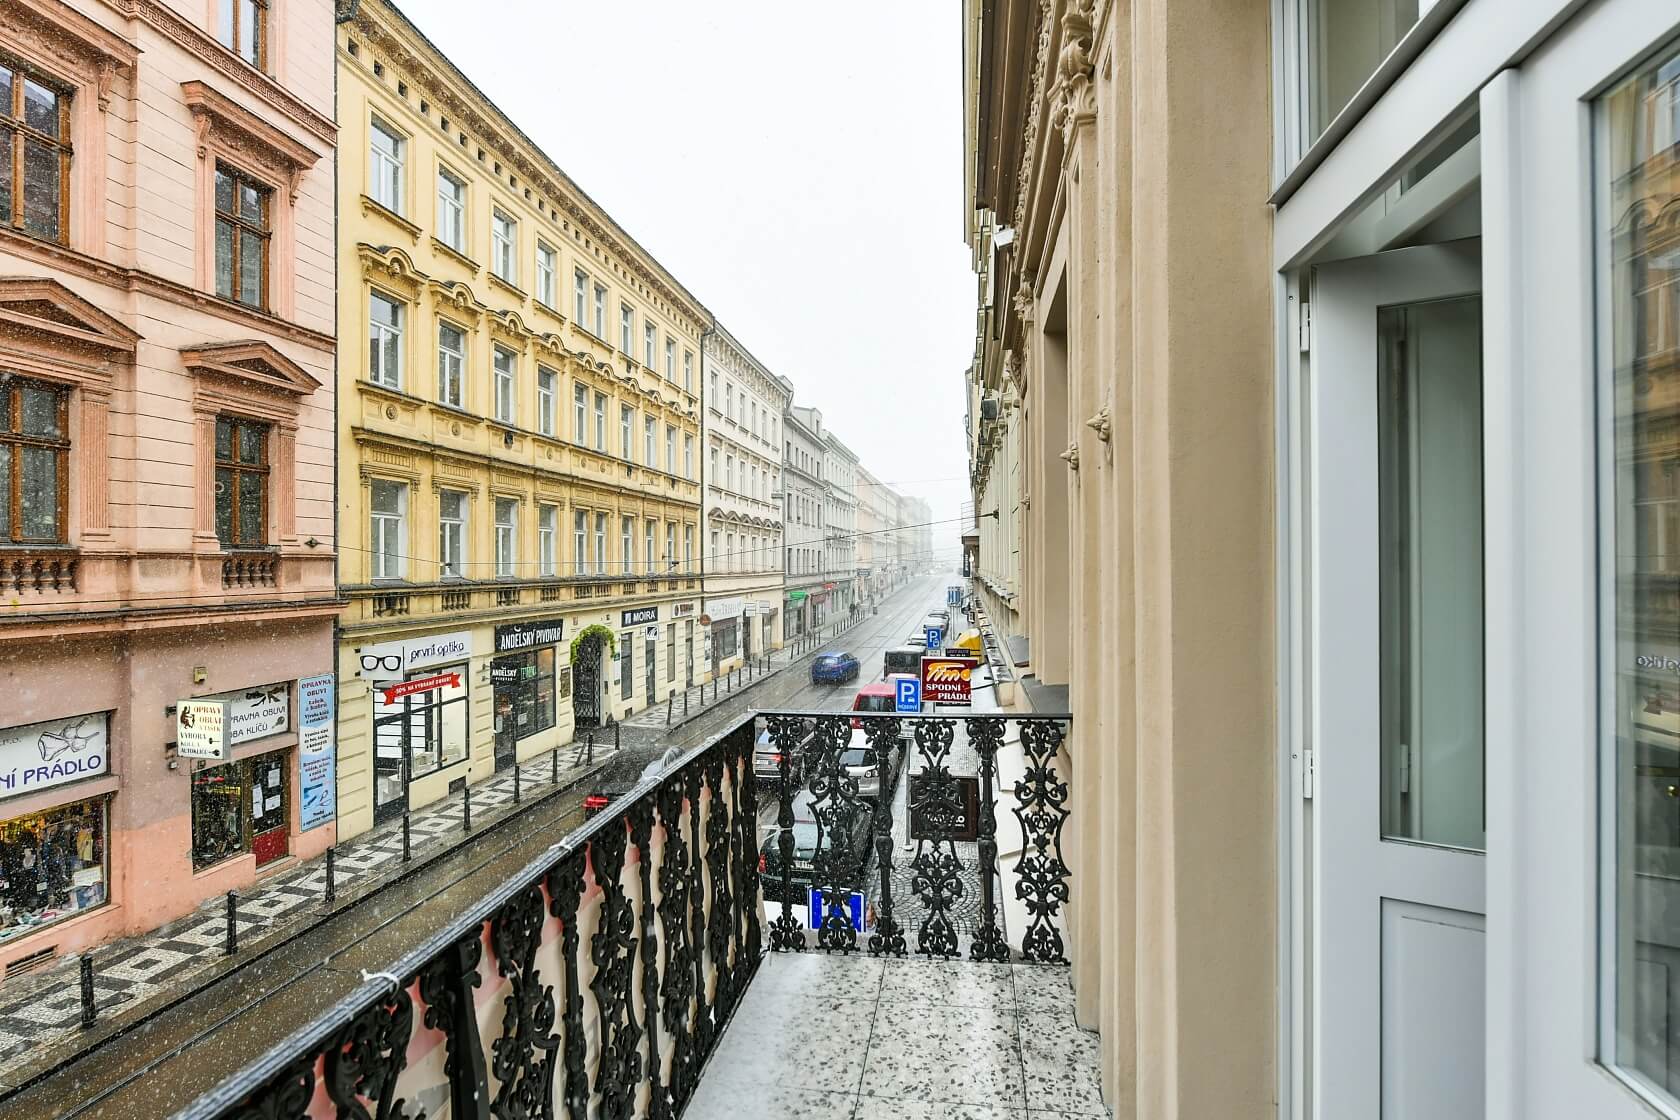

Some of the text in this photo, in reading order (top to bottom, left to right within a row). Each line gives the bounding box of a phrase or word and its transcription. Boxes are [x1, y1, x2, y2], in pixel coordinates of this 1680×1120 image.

[633, 609, 656, 622] MOIRA
[501, 625, 561, 650] ANDĚLSKÝ PIVOVAR
[410, 643, 435, 662] první
[901, 682, 915, 702] P
[926, 683, 961, 691] SPODNÍ
[262, 706, 286, 717] OBUVI
[23, 754, 102, 785] PRÁDLO
